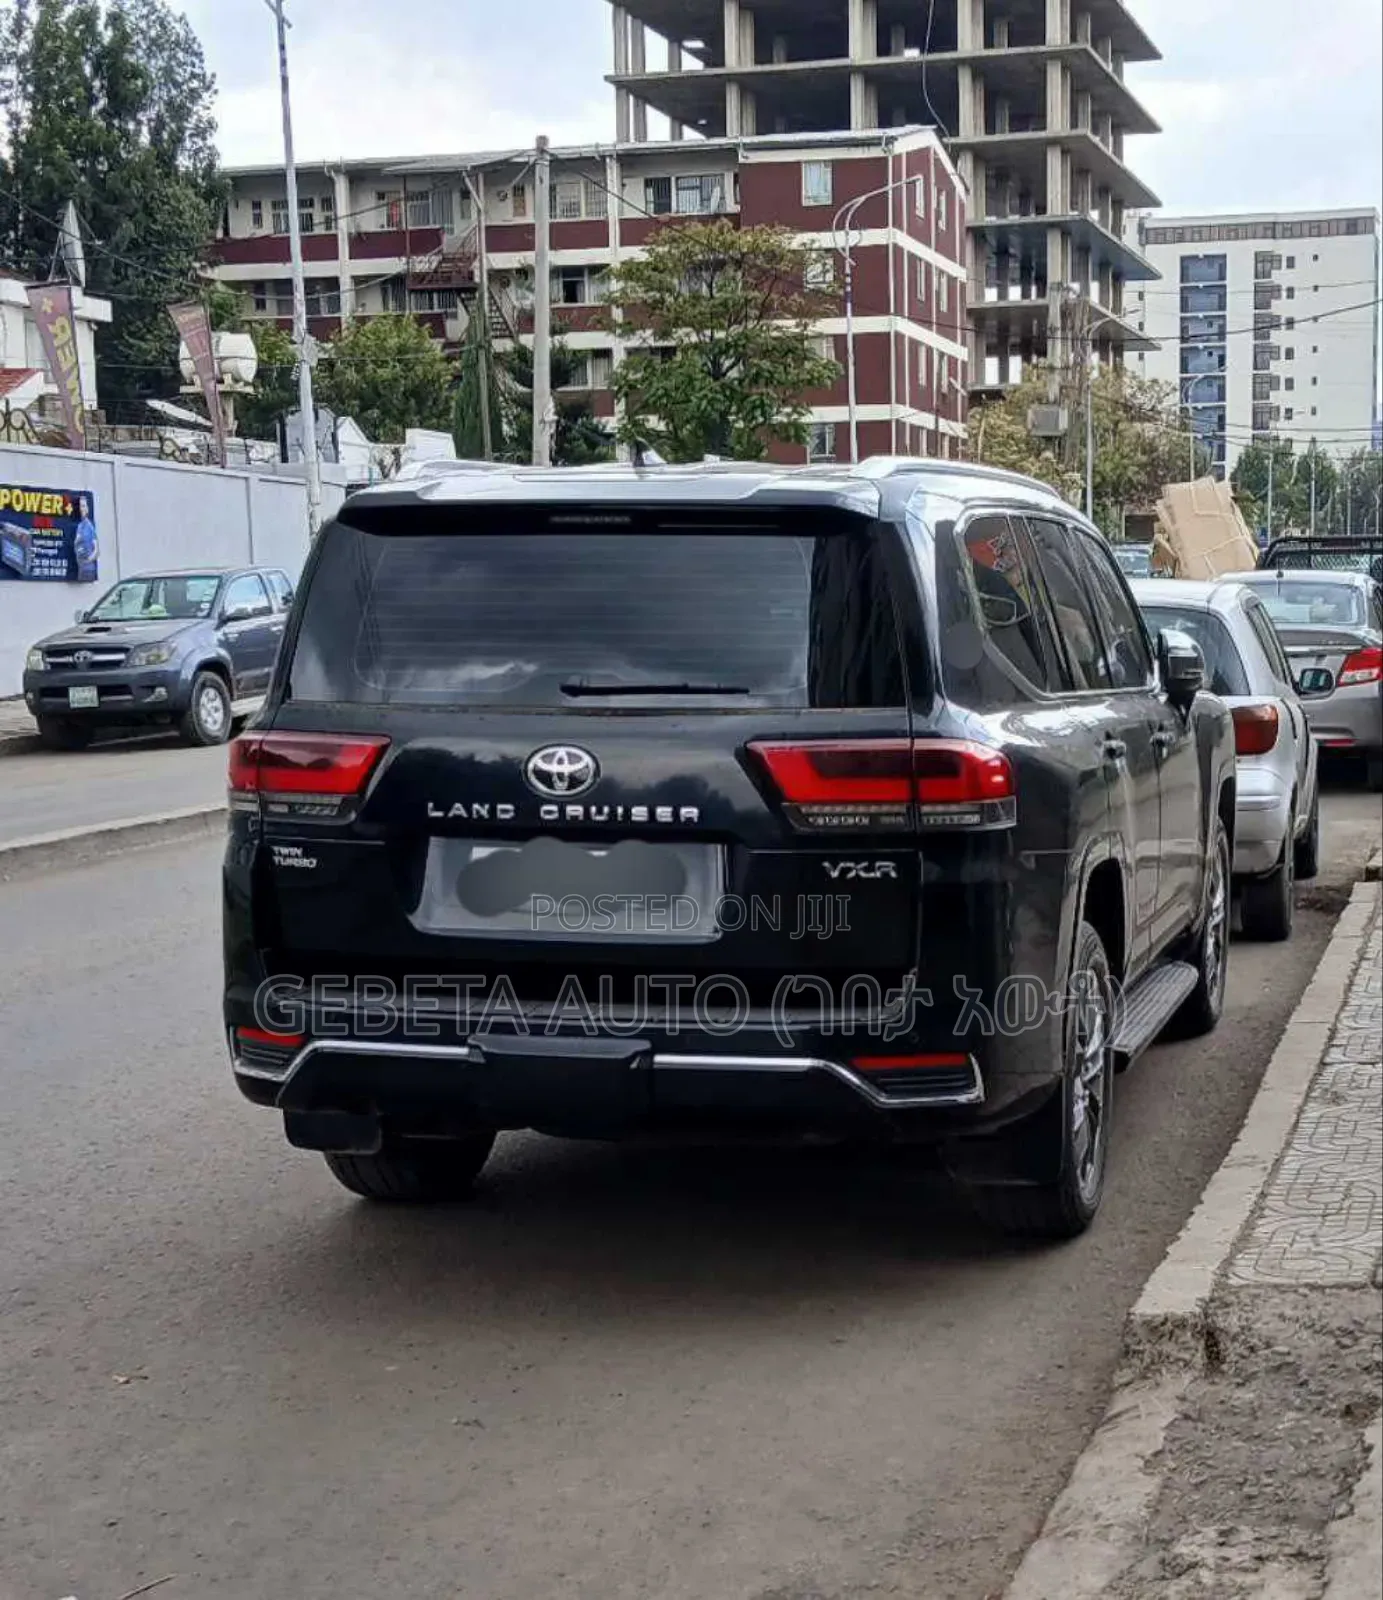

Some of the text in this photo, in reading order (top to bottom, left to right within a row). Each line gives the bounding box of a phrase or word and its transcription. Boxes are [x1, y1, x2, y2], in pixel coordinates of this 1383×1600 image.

[427, 802, 699, 823] LAND CRUISER
[270, 846, 303, 857] TWIN
[272, 856, 317, 868] TURBO
[822, 861, 898, 879] VXR
